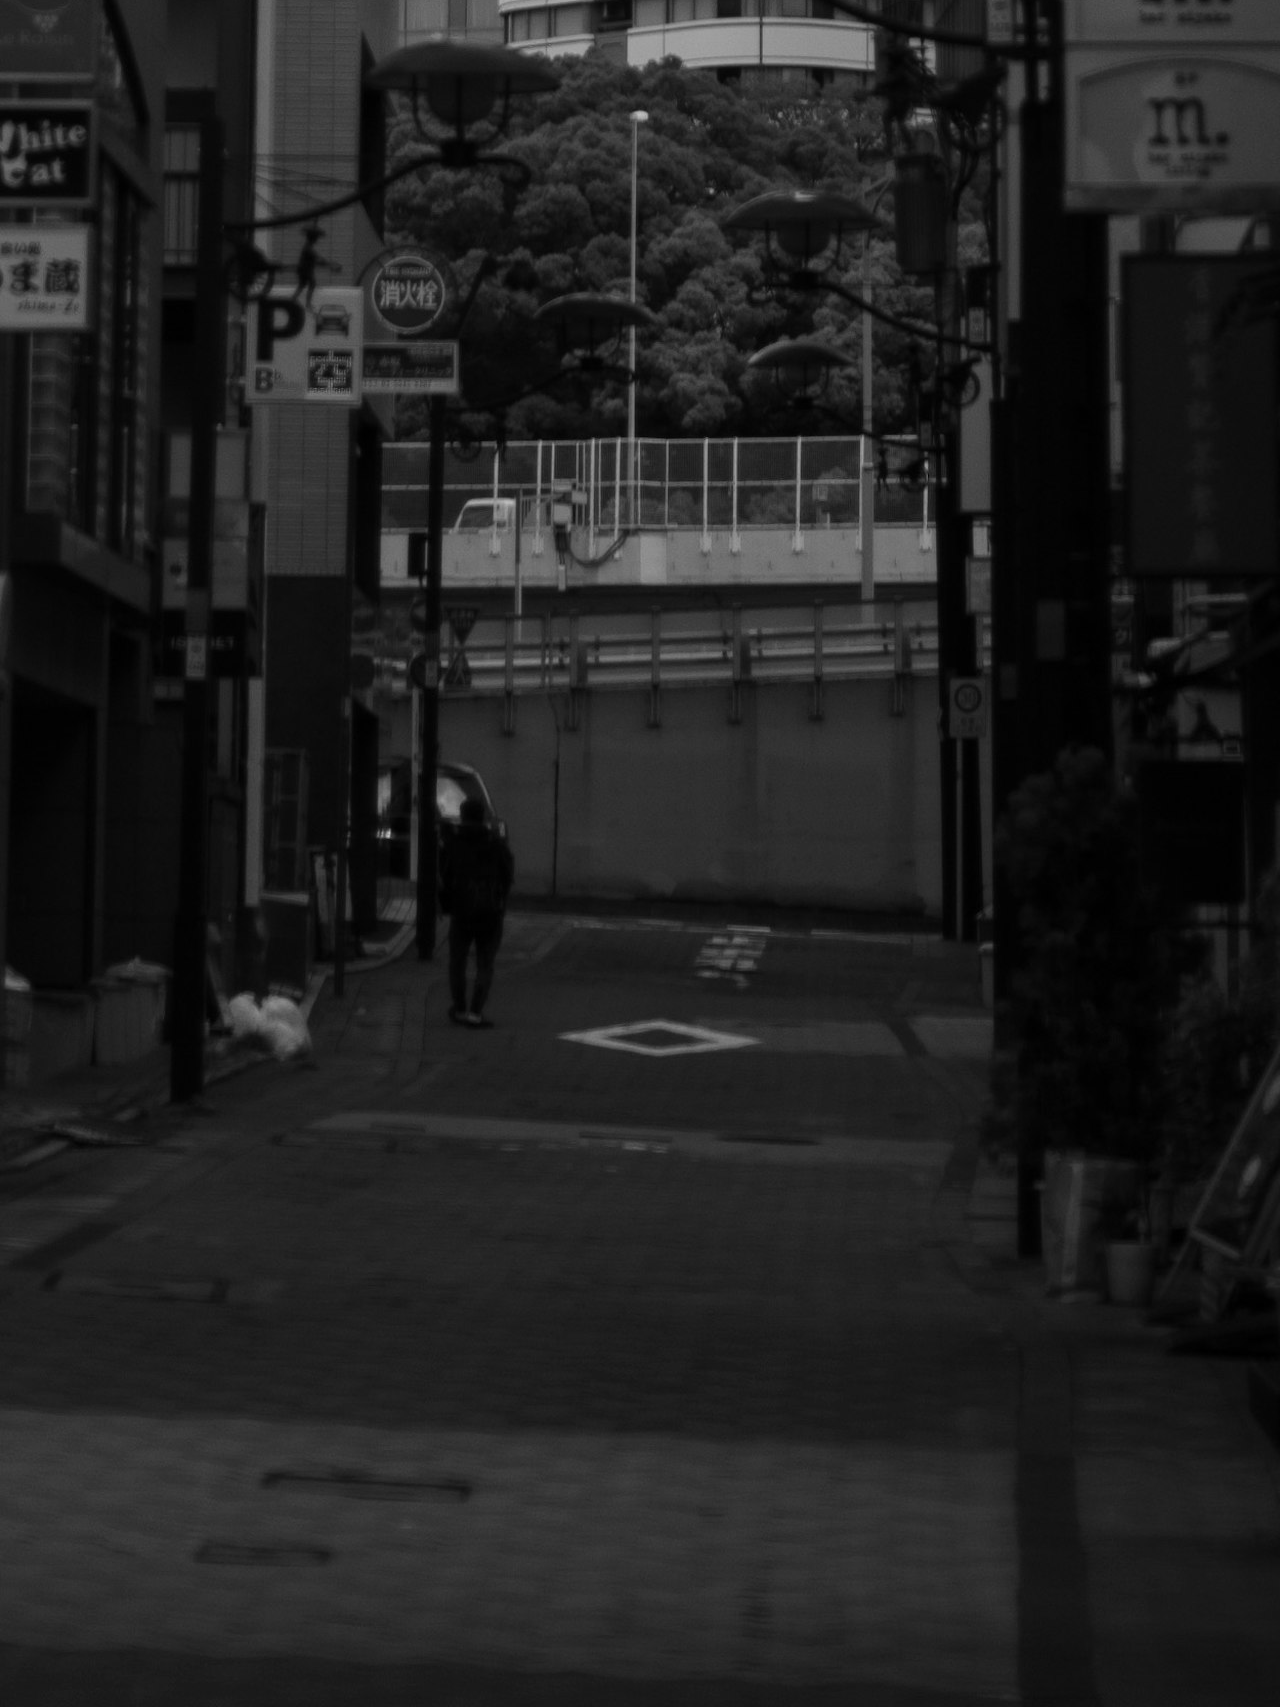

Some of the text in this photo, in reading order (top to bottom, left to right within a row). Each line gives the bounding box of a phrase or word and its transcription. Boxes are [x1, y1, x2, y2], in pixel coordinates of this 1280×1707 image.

[0, 151, 66, 189] Cat
[380, 279, 439, 310] 消火栓
[257, 298, 306, 361] P
[309, 349, 353, 395] 空
